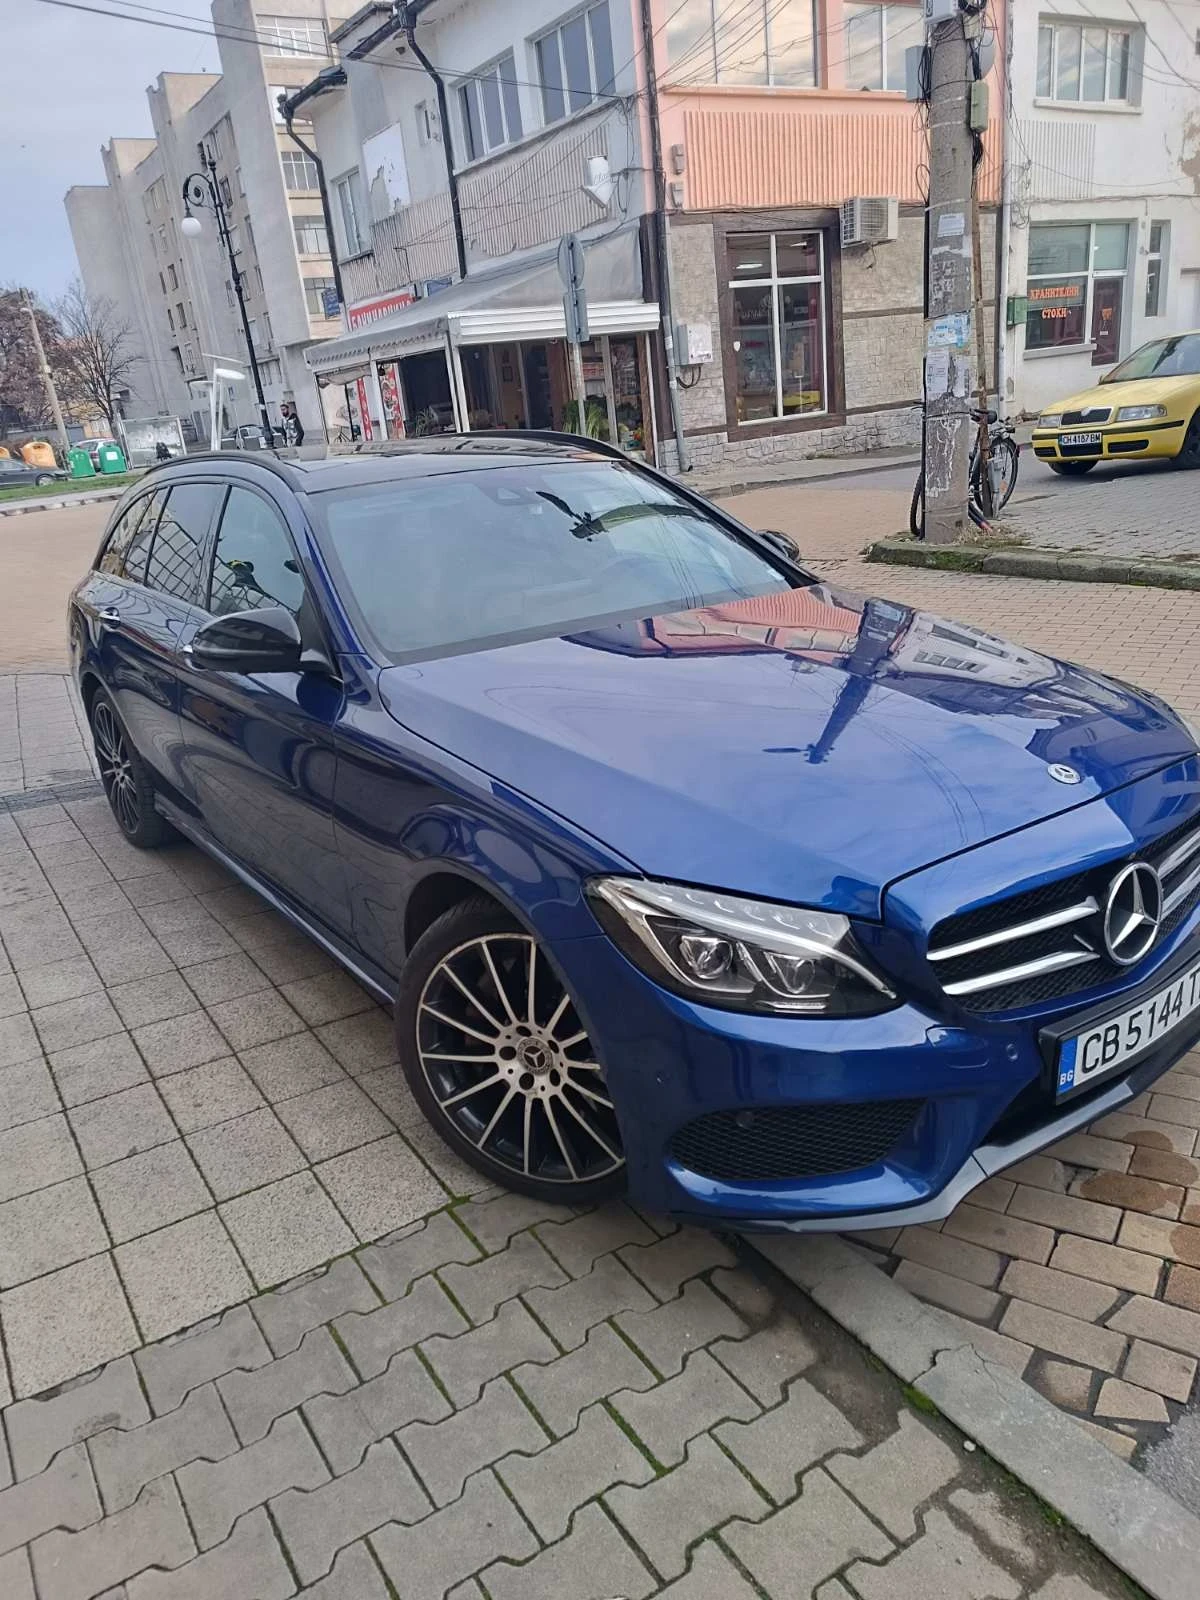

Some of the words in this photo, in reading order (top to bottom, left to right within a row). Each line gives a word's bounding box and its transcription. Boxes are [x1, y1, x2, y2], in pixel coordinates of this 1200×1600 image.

[1081, 1023, 1120, 1074] CB
[1125, 981, 1184, 1051] 5144
[1188, 966, 1200, 1007] T
[1060, 1070, 1074, 1085] BG
